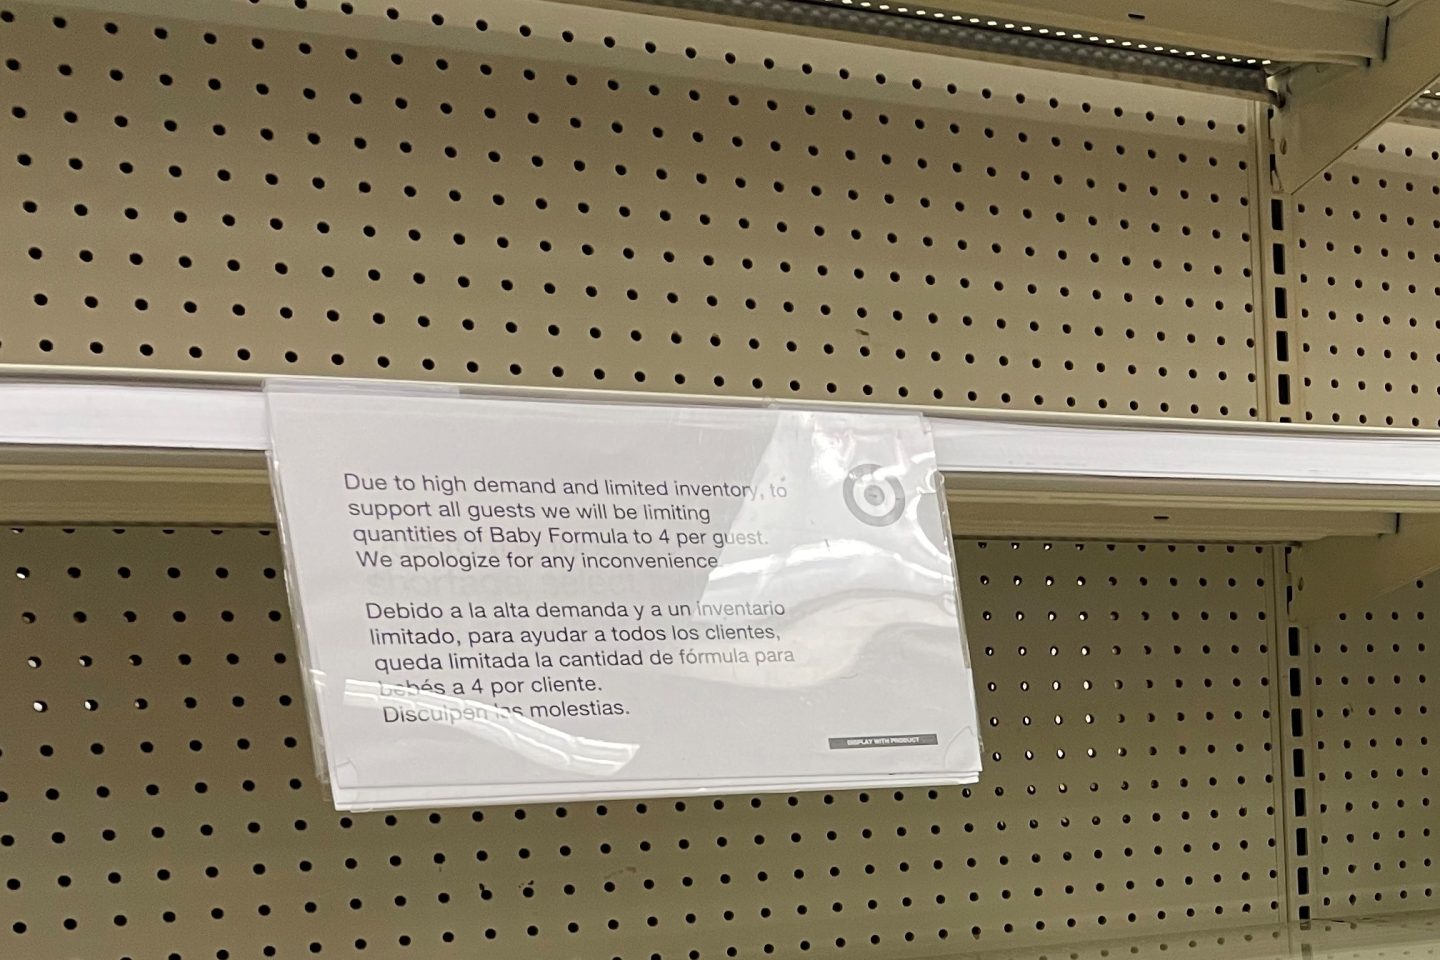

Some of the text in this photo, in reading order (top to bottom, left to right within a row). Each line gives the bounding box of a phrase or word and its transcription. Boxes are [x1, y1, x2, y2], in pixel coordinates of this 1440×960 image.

[344, 473, 787, 501] Due to high demand and limited inventory, to
[348, 501, 711, 524] support all guests we will be limiting
[353, 526, 769, 548] quantities of Baby Formula to 4 per guest.
[356, 550, 393, 567] We
[400, 551, 500, 571] apologize
[506, 552, 534, 568] for
[541, 555, 575, 572] any
[366, 600, 785, 620] Debido a la alta demanda y a un inventario
[370, 624, 781, 647] limitado, para ayudar a todos los clientes,
[375, 648, 795, 674] queda limitada la cantidad de fórmula para
[453, 682, 465, 695] a
[471, 678, 483, 694] 4
[491, 680, 524, 697] por
[531, 677, 602, 693] cliente.
[530, 700, 630, 717] molestias.
